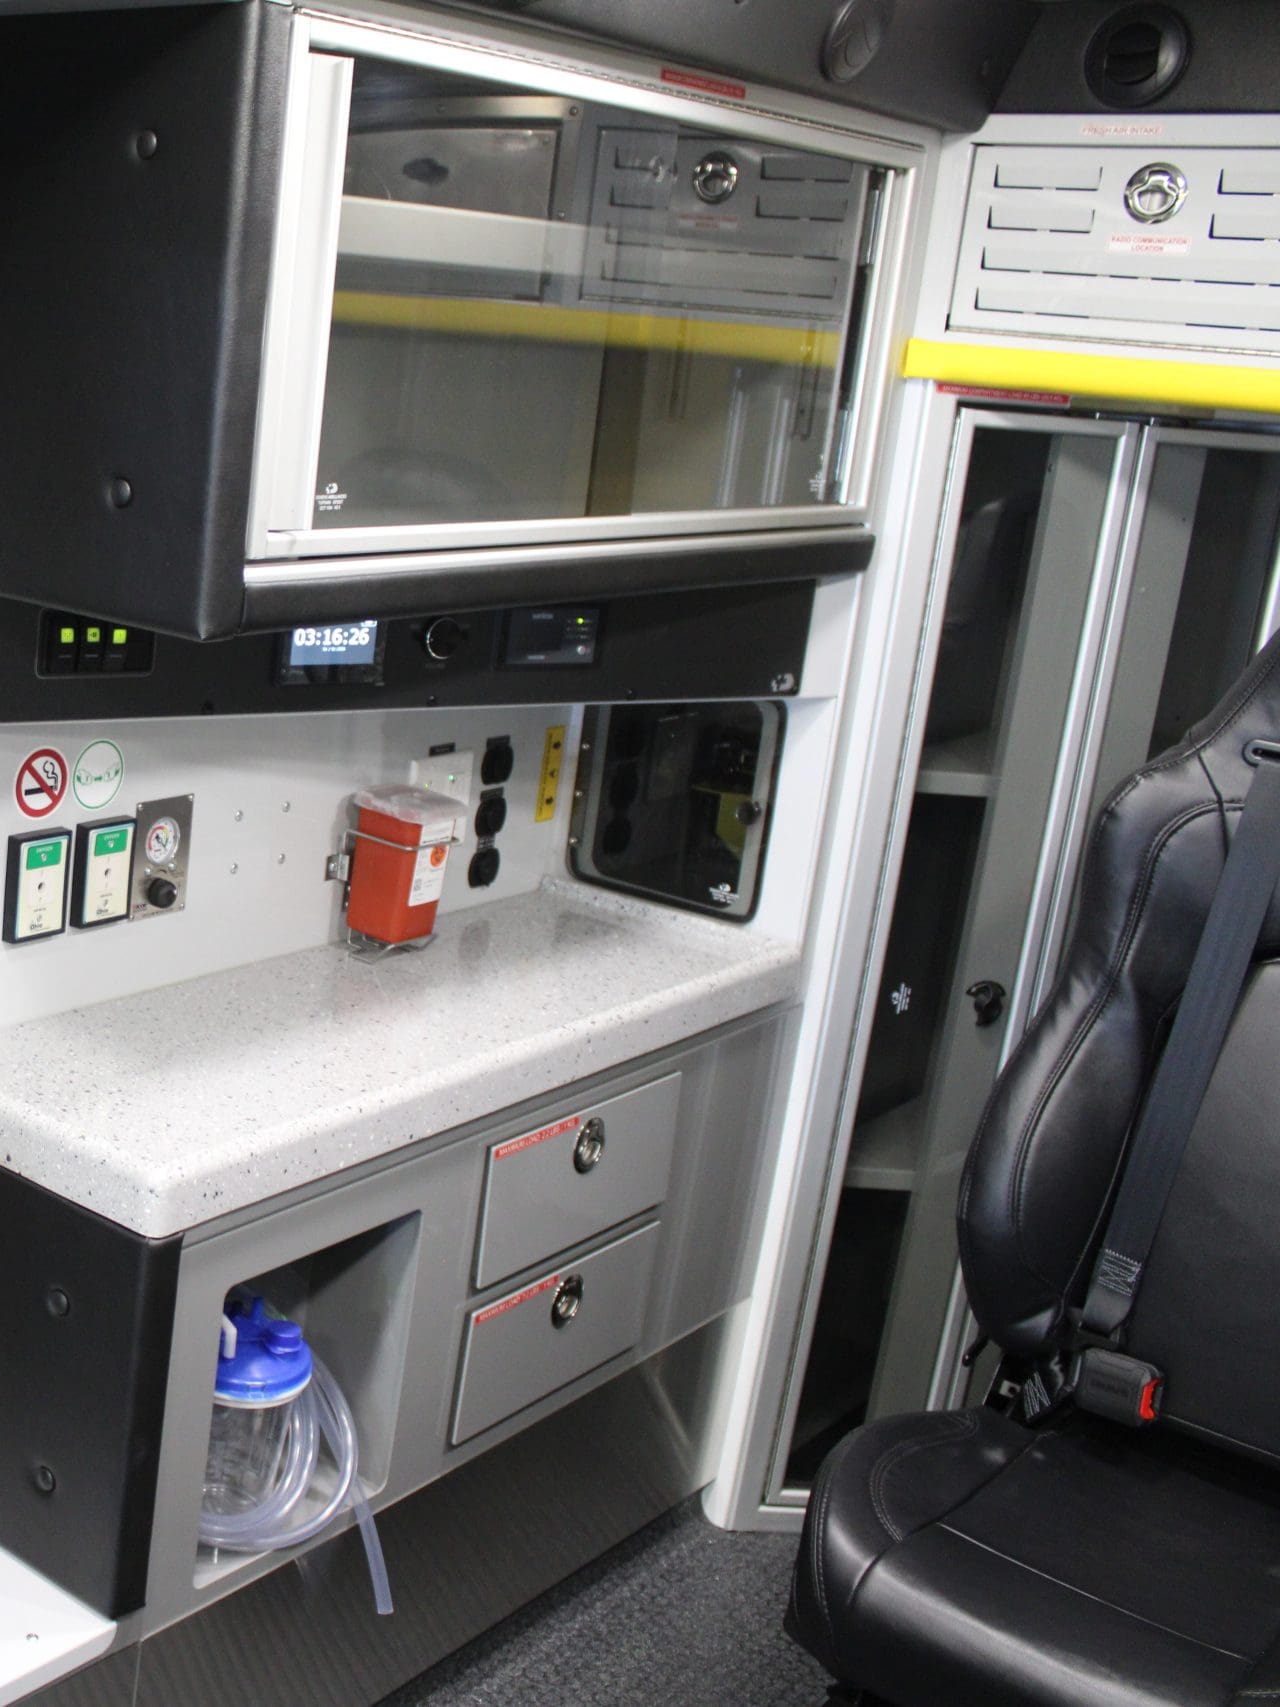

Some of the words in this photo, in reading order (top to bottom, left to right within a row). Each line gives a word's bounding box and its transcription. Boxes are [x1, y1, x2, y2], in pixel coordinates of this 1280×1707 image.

[1113, 127, 1126, 135] AIR
[1129, 127, 1159, 135] INTAKE
[1134, 237, 1188, 245] COMMUNICATION
[294, 627, 370, 646] 03:16:26
